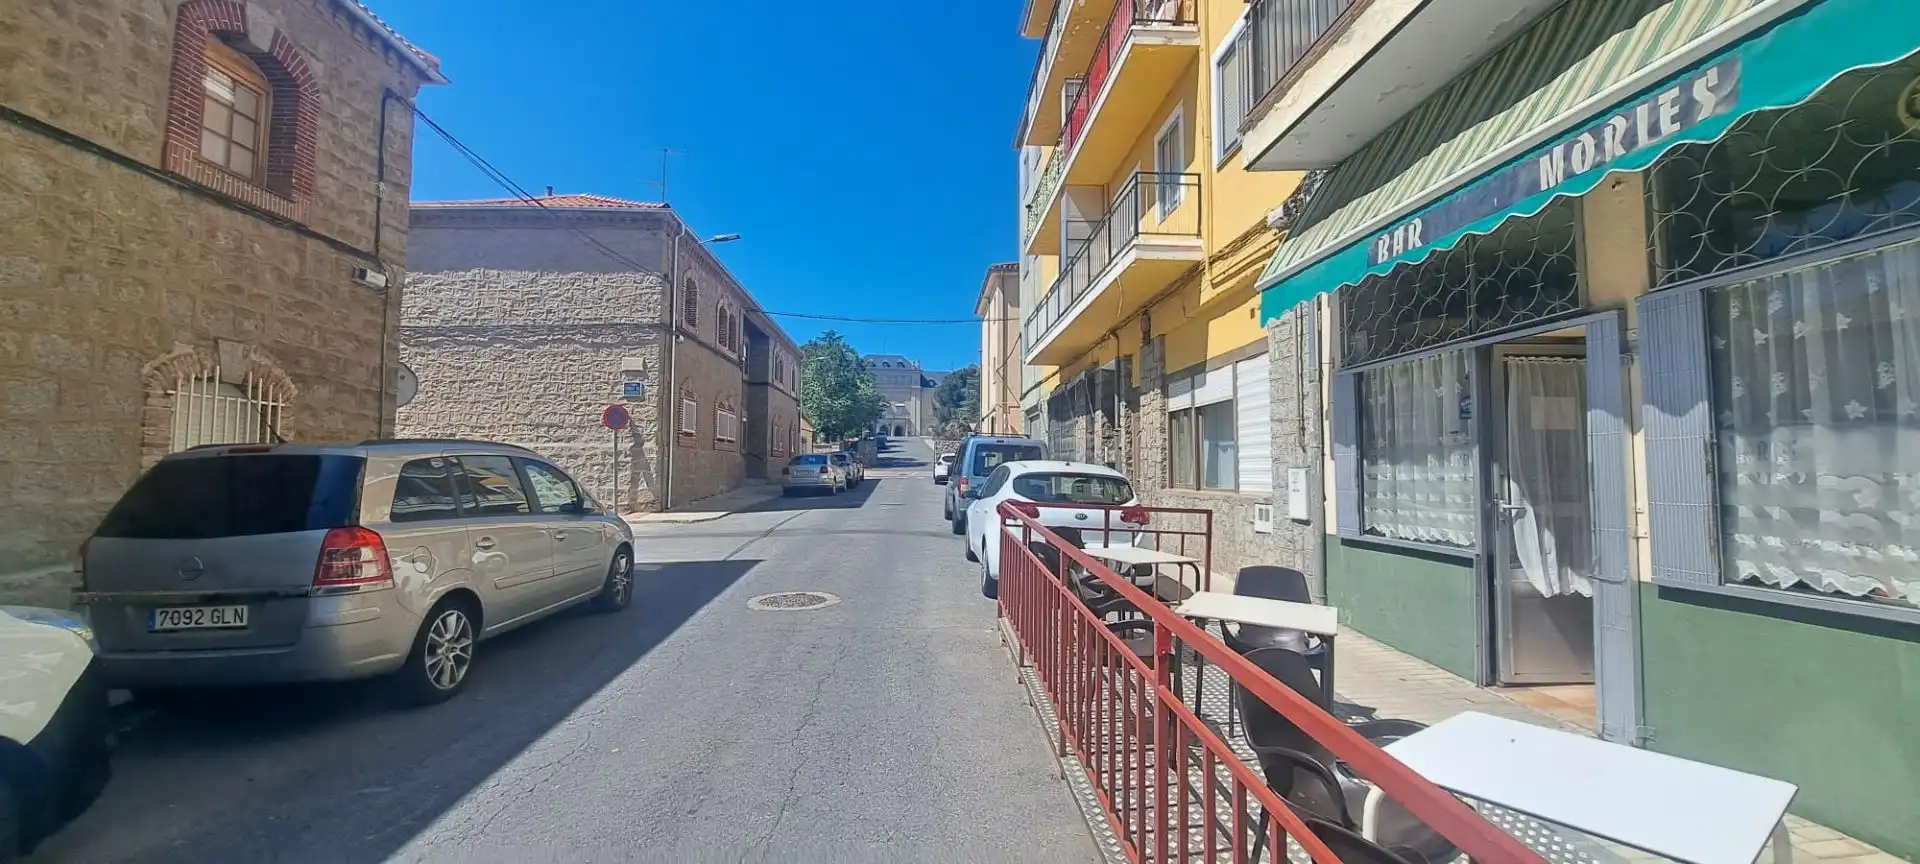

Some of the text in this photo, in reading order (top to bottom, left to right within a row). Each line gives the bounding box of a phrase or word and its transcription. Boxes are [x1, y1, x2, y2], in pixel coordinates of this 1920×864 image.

[1377, 217, 1423, 264] BAR
[159, 607, 245, 627] 7092 GLN
